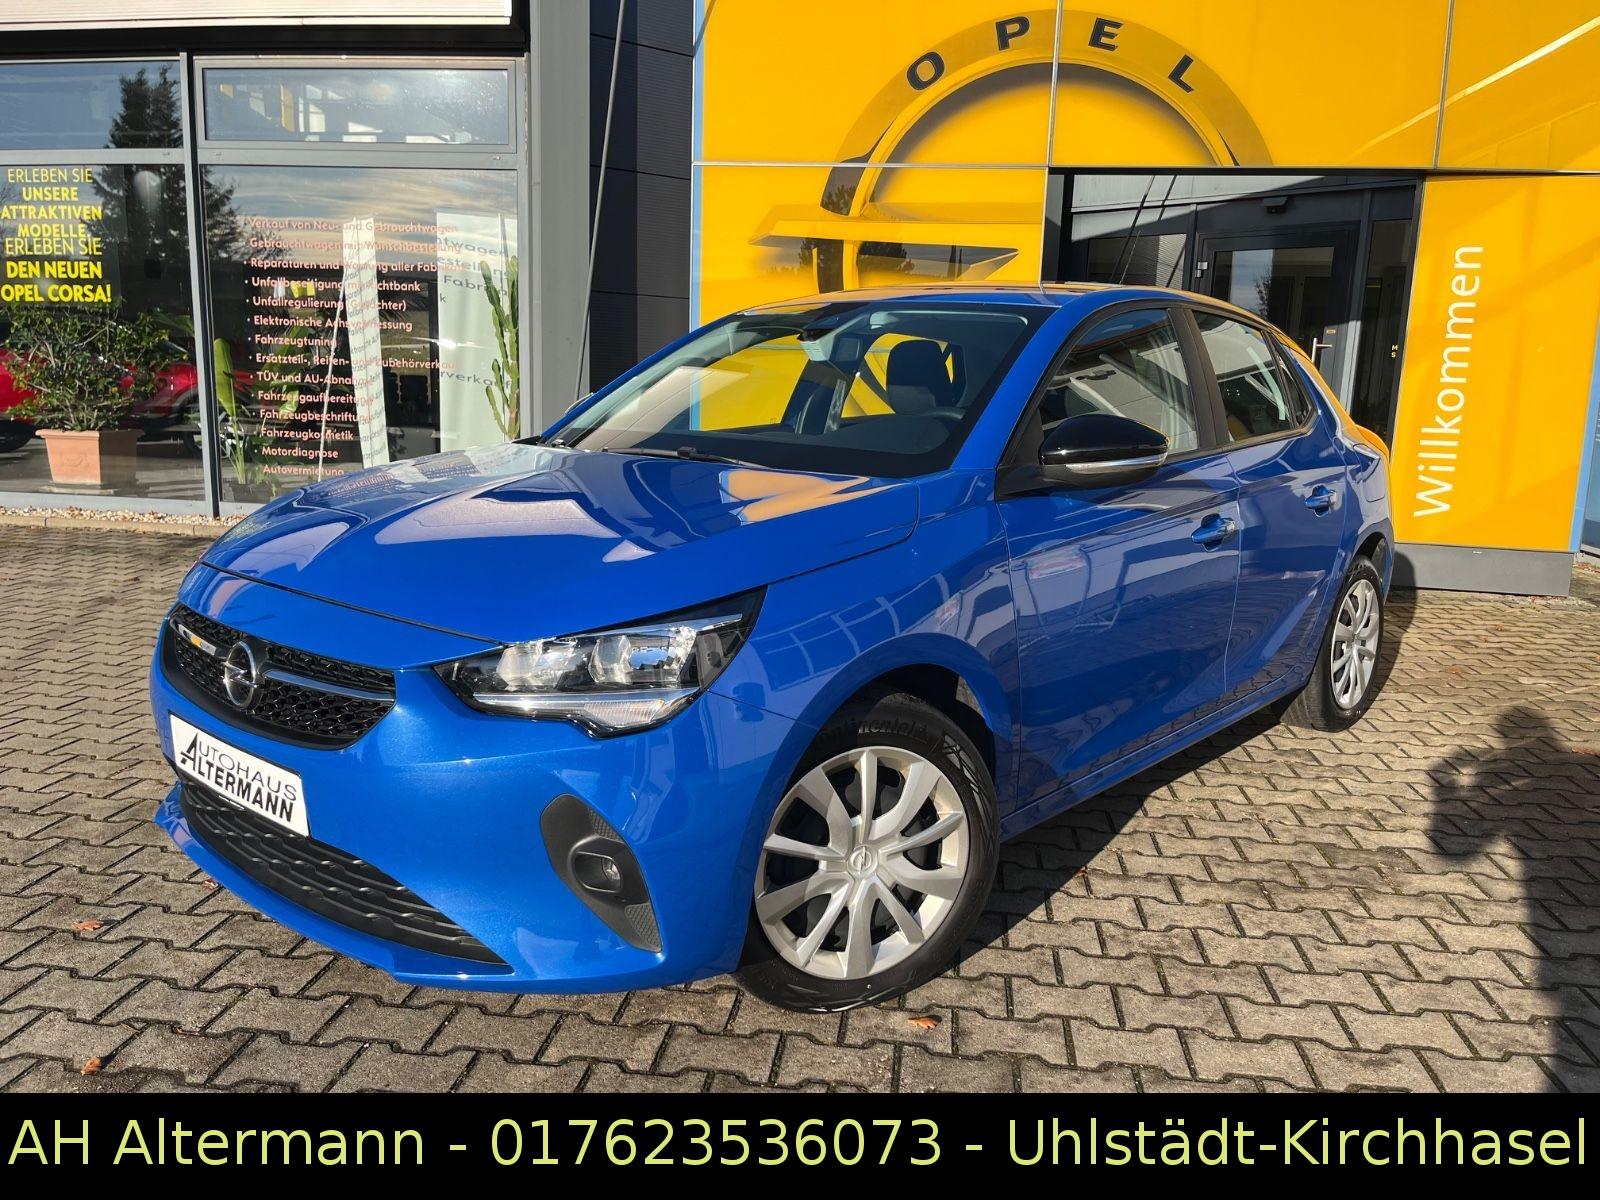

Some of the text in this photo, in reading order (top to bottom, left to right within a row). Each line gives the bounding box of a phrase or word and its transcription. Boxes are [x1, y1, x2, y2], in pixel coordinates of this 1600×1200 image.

[906, 16, 1194, 93] OPEL
[7, 168, 94, 183] ERLEBEN SIE
[22, 186, 79, 201] UNSERE
[0, 204, 103, 220] ATTRAKTIVEN
[18, 223, 91, 238] MODELLE.
[248, 217, 289, 229] Verkauf
[291, 221, 311, 230] von
[5, 238, 103, 256] ERLEBEN SIE
[250, 237, 341, 251] Gebrauchtwagen
[6, 260, 103, 279] DEN NEUEN
[250, 257, 317, 270] Reparaturen
[319, 259, 340, 270] und
[391, 261, 415, 272] aller
[251, 276, 344, 291] Unfallbeseitigung
[367, 279, 421, 292] chtbank
[0, 284, 112, 302] OPEL CORSA!
[252, 295, 344, 310] Unfallregulierung
[253, 315, 322, 328] Elektronische
[254, 334, 337, 348] Fahrzeugtuning
[313, 354, 350, 366] Reifen-
[257, 370, 279, 381] TÜV
[281, 373, 301, 383] und
[1413, 246, 1483, 517] Willkommen
[261, 427, 354, 441] Fahrzeugkometik
[261, 446, 339, 459] Motordiagnose
[180, 732, 297, 801] AUTOHAUS
[180, 732, 294, 823] ALTERMANN
